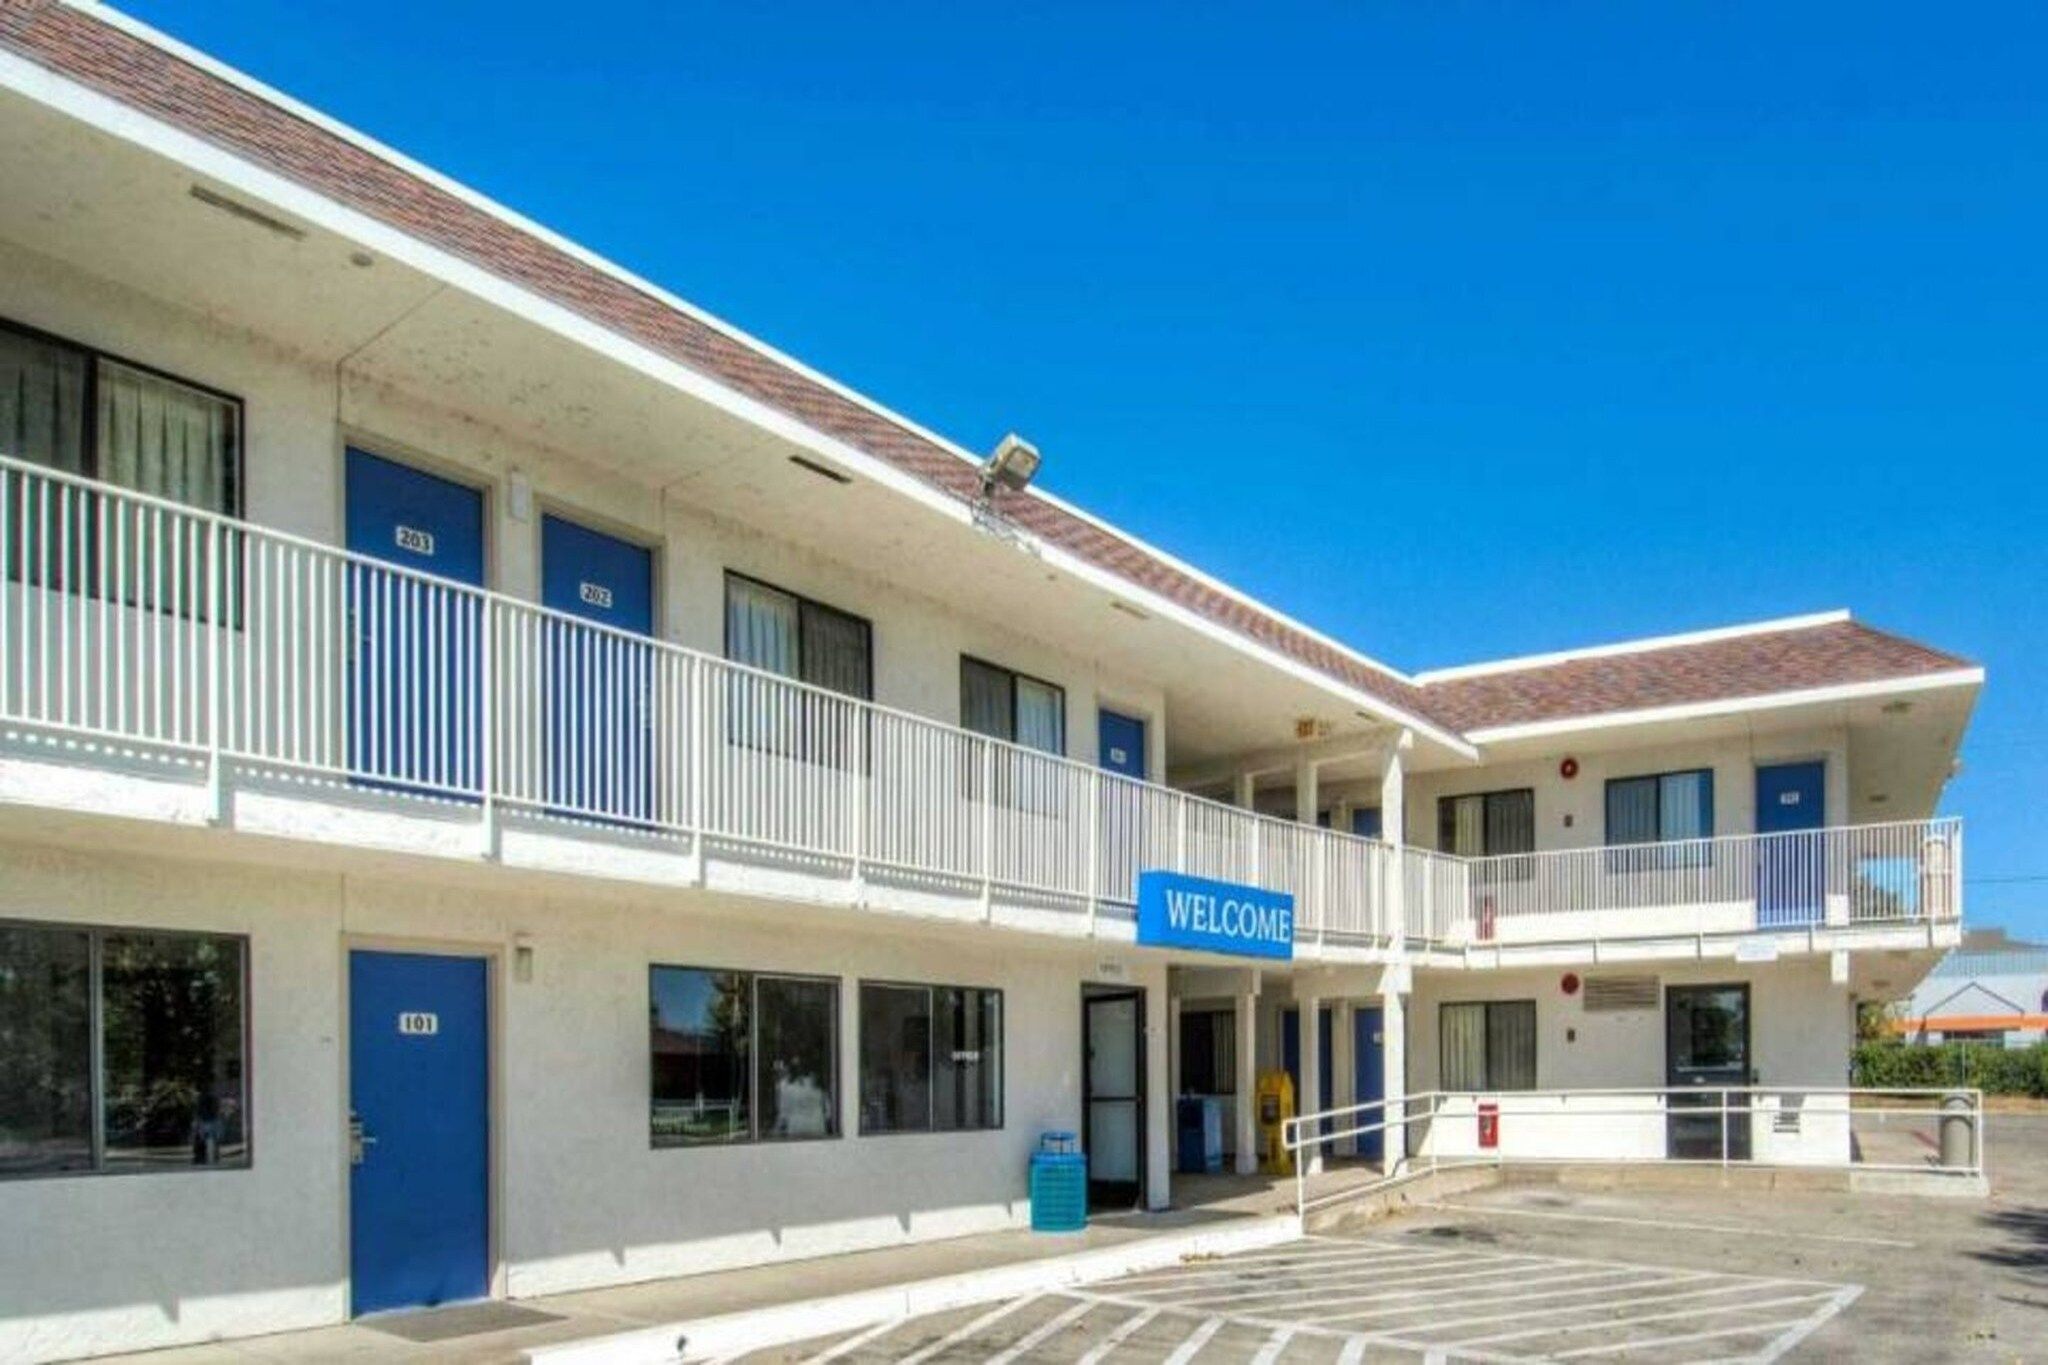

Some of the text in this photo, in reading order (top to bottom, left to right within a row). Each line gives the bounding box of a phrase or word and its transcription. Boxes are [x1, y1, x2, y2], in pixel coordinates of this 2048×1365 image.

[400, 529, 430, 551] 203
[584, 585, 609, 604] 202
[1166, 889, 1291, 942] WELCOME
[406, 1015, 433, 1032] 101
